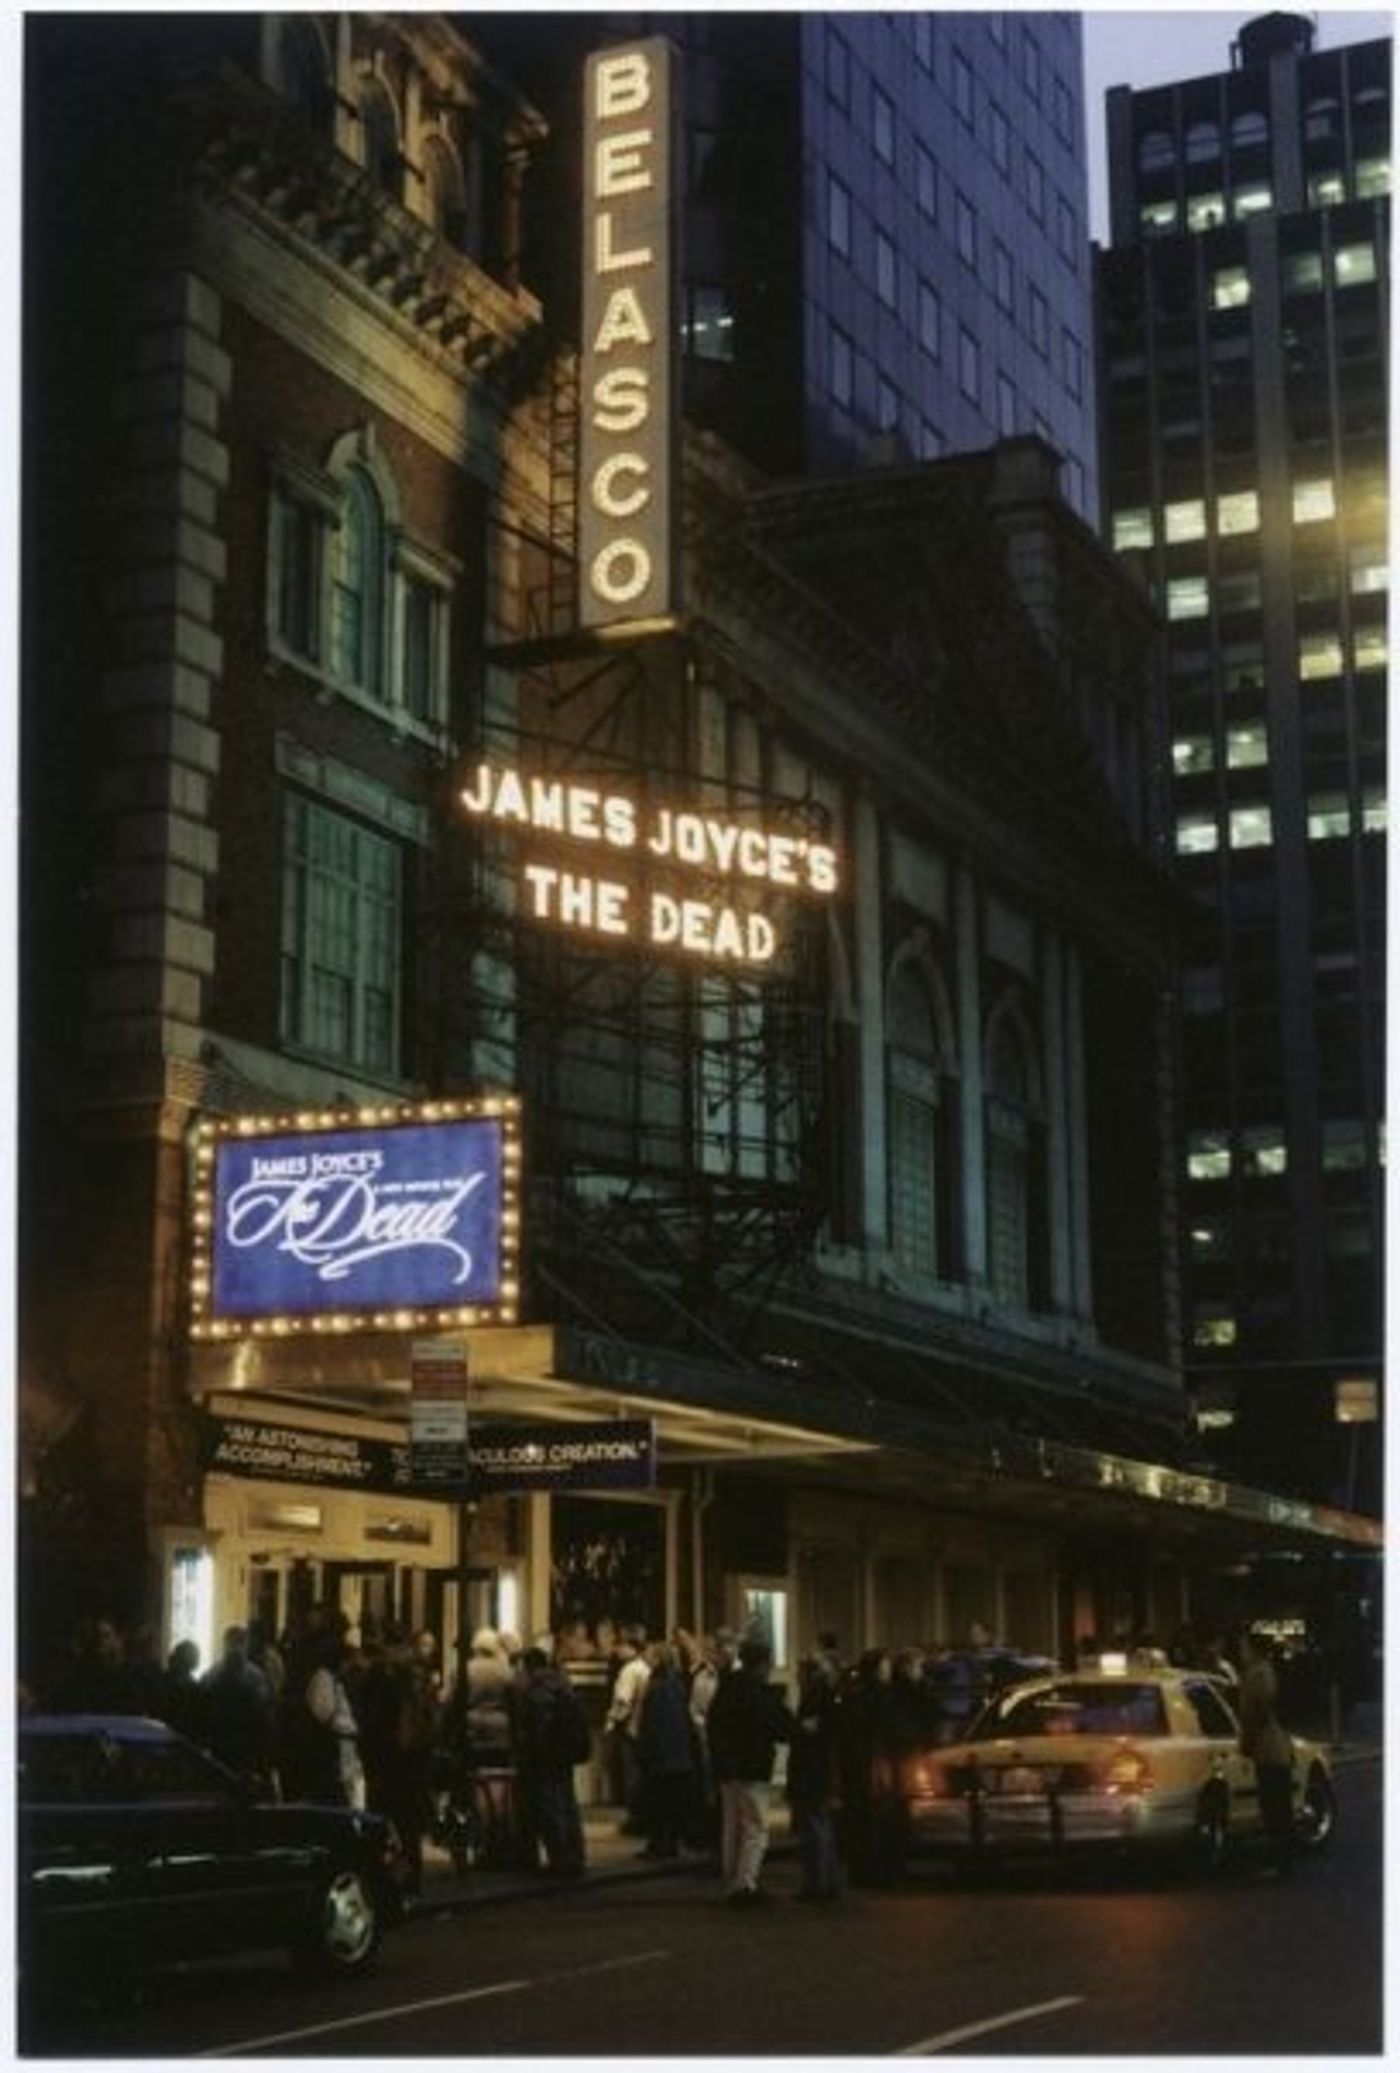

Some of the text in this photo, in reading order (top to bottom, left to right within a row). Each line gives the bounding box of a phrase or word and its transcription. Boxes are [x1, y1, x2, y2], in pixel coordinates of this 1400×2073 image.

[589, 52, 653, 605] BELASCO
[460, 764, 840, 894] JAMES JOYCE'S
[524, 864, 777, 961] THE DEAD
[252, 1150, 383, 1179] JAMES JOYCE'S
[279, 1171, 487, 1284] Dead
